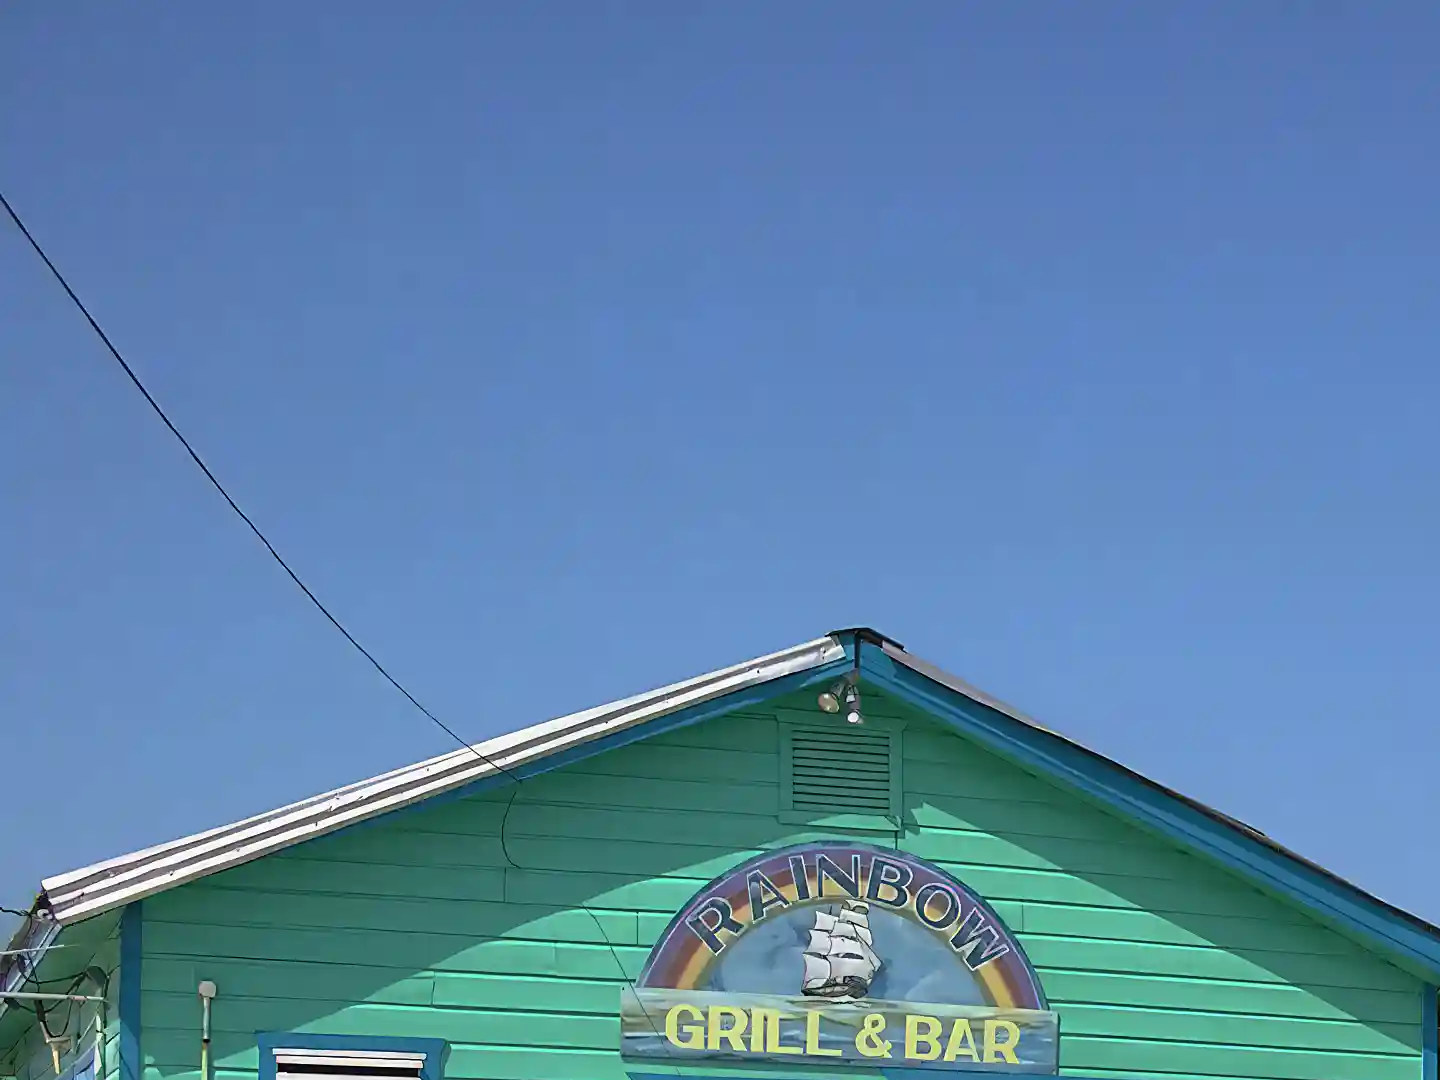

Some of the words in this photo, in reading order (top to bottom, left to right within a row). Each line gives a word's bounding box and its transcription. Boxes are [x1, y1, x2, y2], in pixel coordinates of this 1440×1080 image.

[686, 853, 1009, 971] RAINBOW
[665, 1003, 842, 1057] GRILL
[854, 1013, 893, 1059] &
[904, 1014, 1021, 1065] BAR
